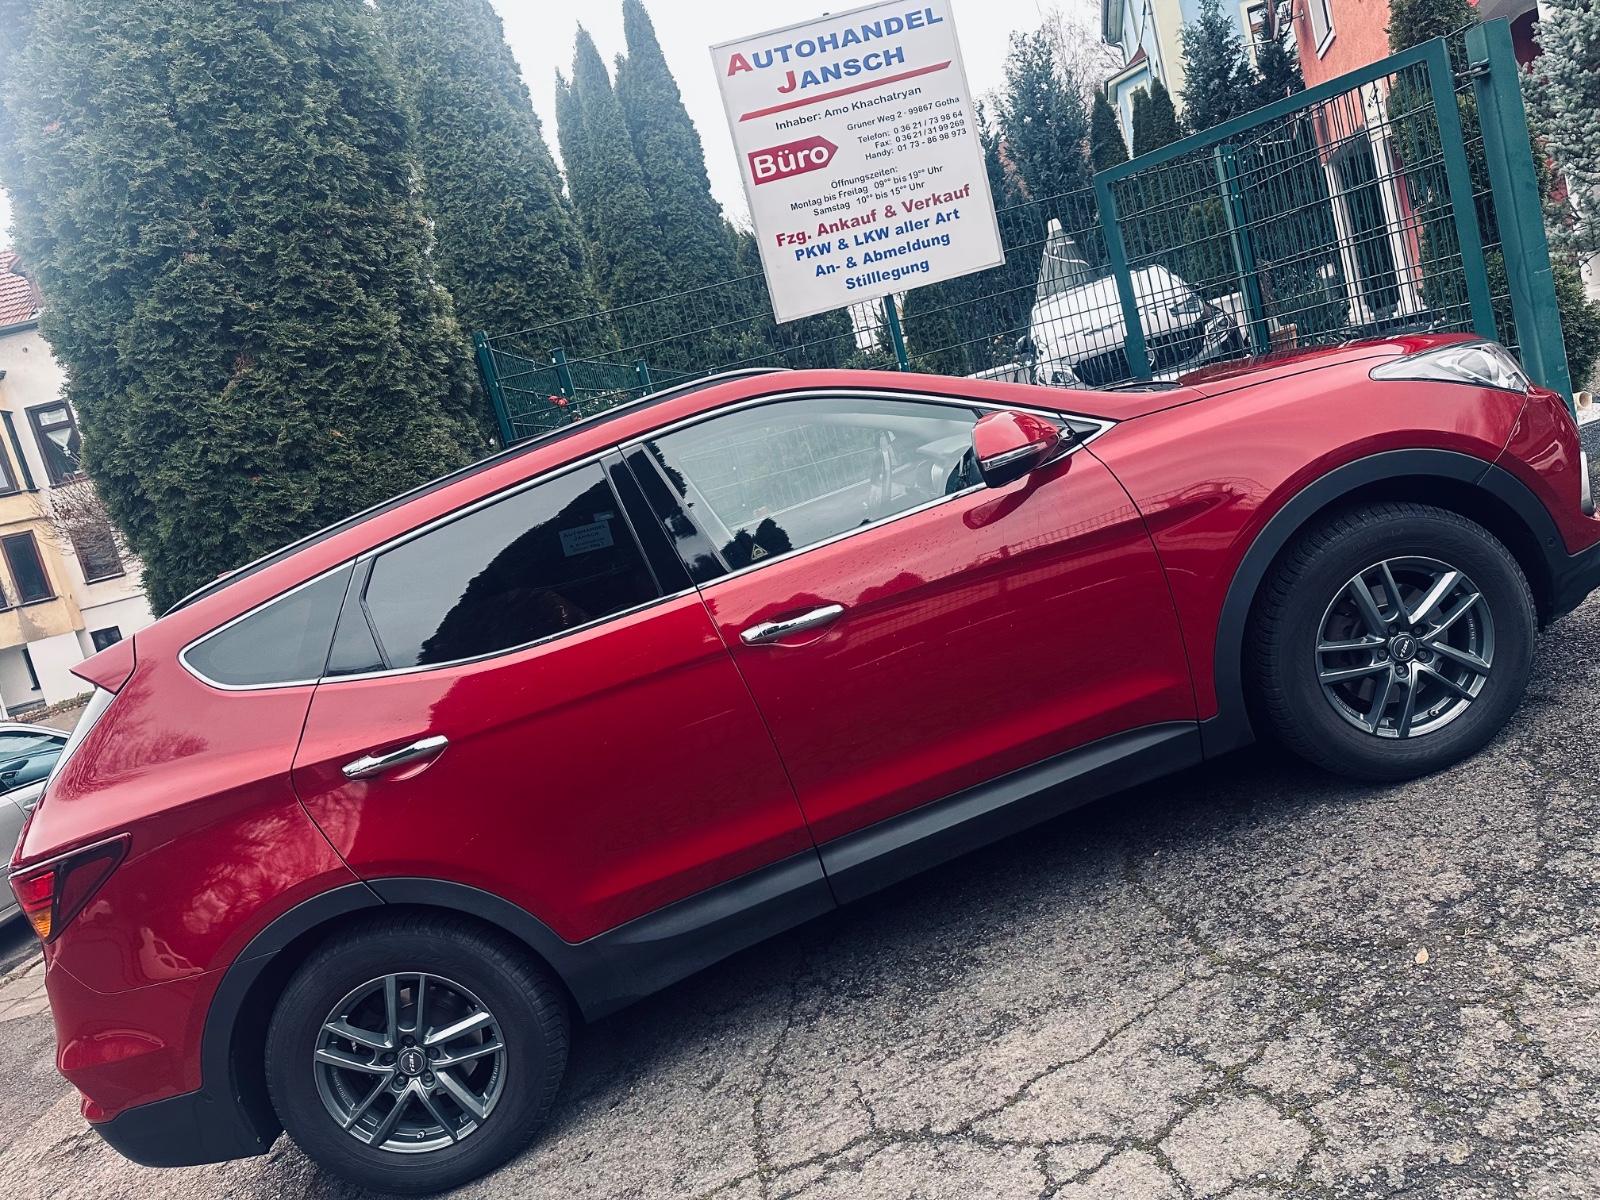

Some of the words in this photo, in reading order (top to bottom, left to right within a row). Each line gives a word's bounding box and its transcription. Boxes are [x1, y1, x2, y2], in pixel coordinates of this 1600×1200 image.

[727, 7, 944, 77] AUTOHANDEL
[776, 45, 905, 94] JANSCH
[775, 113, 822, 131] Inhaber:
[824, 106, 850, 118] Amo
[851, 87, 922, 111] Khachatryan
[876, 114, 896, 124] Weg
[896, 110, 903, 119] 2
[907, 102, 933, 115] 99867
[934, 97, 960, 108] Gotha
[857, 131, 891, 144] Telefon:
[864, 148, 894, 161] Handy:
[874, 139, 892, 149] Fax:
[753, 145, 829, 179] Büro
[830, 166, 898, 189] Öffnungszeiten:
[790, 198, 823, 211] Montag
[823, 194, 837, 203] bis
[837, 186, 869, 199] Freitag
[892, 175, 908, 185] bis
[927, 165, 943, 175] Uhr
[813, 201, 851, 217] Samstag
[874, 191, 889, 200] bis
[908, 181, 925, 191] Uhr
[775, 231, 812, 248] Fzg.
[817, 208, 877, 237] Ankauf
[884, 204, 898, 219] &
[900, 183, 970, 213] Verkauf
[794, 241, 831, 262] PKW
[837, 238, 850, 251] &
[853, 226, 889, 247] LKW
[894, 217, 930, 236] aller
[935, 208, 961, 225] Art
[815, 264, 841, 278] An-
[846, 256, 858, 269] &
[863, 233, 951, 265] Abmeldung
[845, 260, 930, 290] Stilllegung
